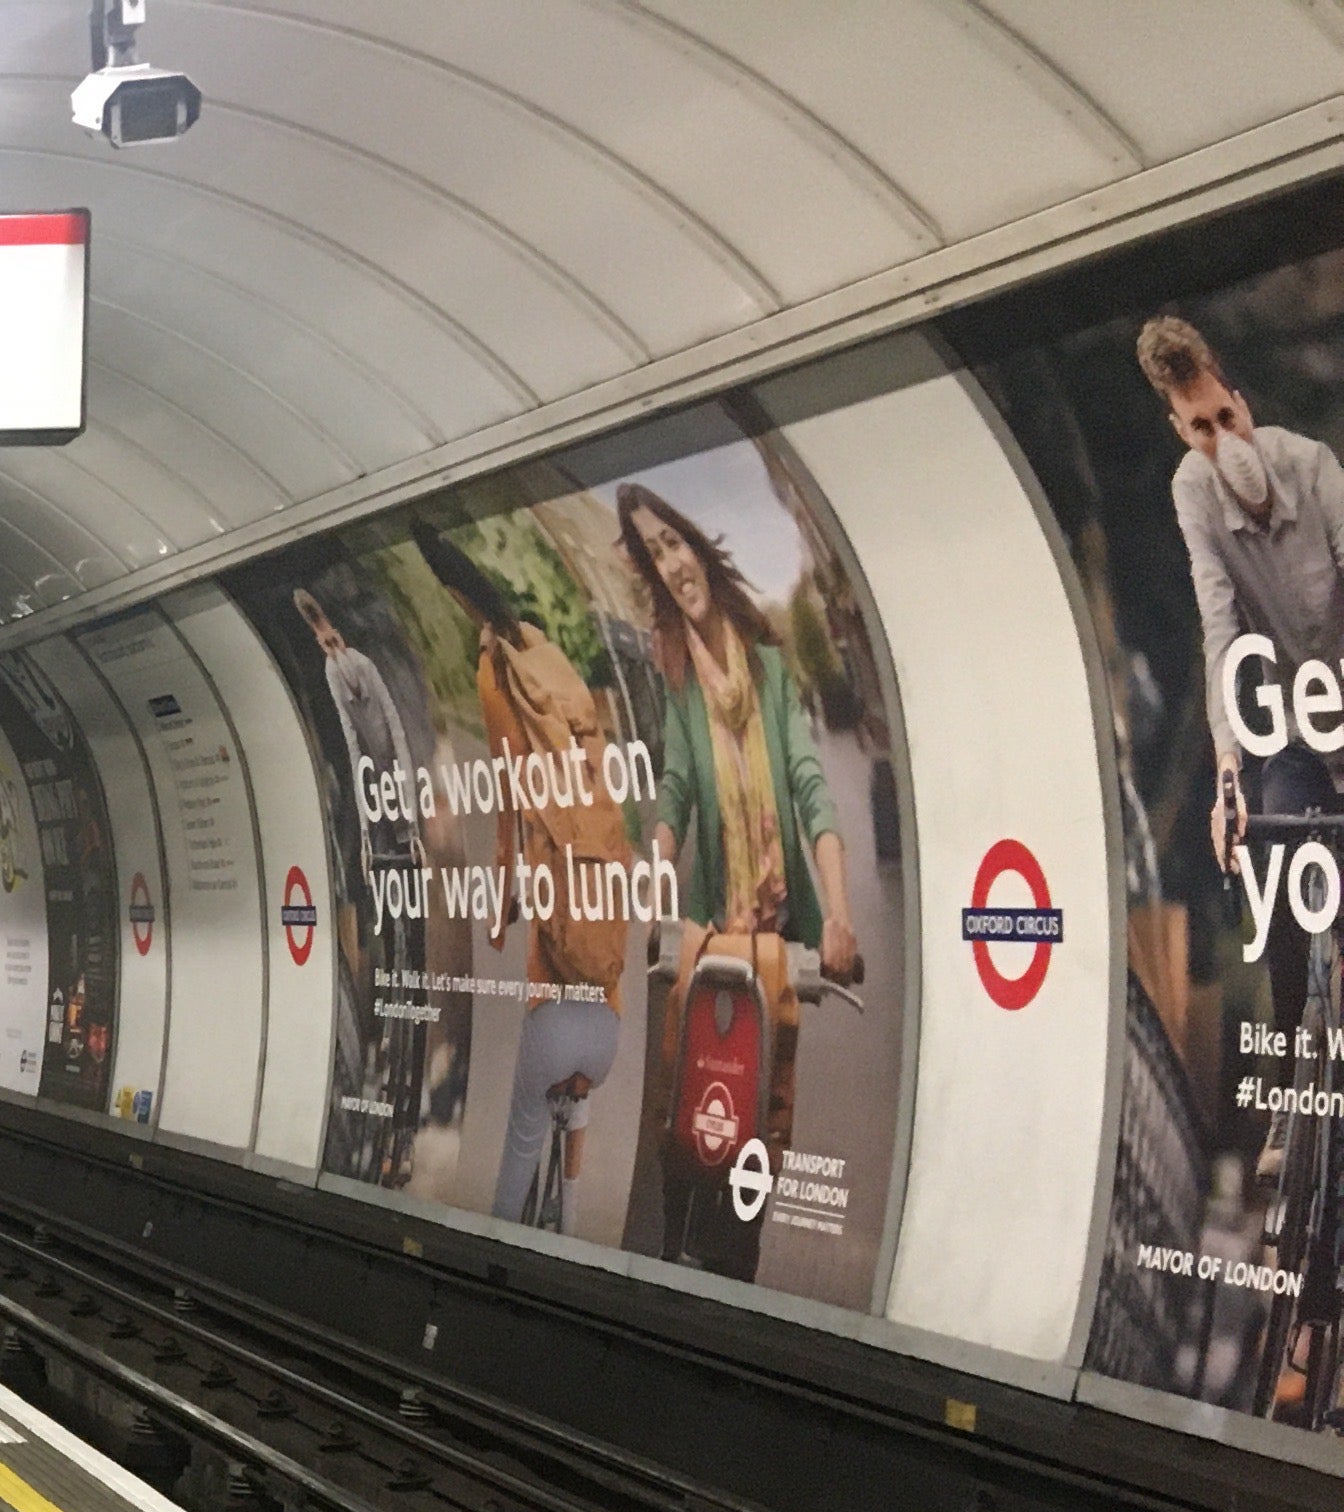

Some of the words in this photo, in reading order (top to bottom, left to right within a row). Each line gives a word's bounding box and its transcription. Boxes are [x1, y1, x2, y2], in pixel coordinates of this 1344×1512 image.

[1223, 633, 1344, 757] Ge
[357, 755, 411, 822] Get
[417, 766, 436, 818] a
[442, 736, 594, 816] workout
[602, 740, 656, 803] on
[369, 867, 432, 935] your
[441, 865, 506, 938] way
[517, 853, 555, 921] to
[566, 839, 679, 922] lunch
[966, 915, 1013, 934] OXFORD
[1016, 916, 1059, 935] CIRCUS
[453, 974, 474, 993] make
[499, 981, 524, 1001] every
[525, 981, 562, 1004] journey
[1240, 1022, 1286, 1057] Bike
[1295, 1026, 1318, 1059] it.
[783, 1150, 846, 1179] TRANSPORT
[777, 1177, 799, 1198] FOR
[800, 1181, 849, 1208] LONDON
[1137, 1244, 1192, 1276] MAYOR
[1197, 1255, 1222, 1281] OF
[1224, 1262, 1304, 1298] LONDON
